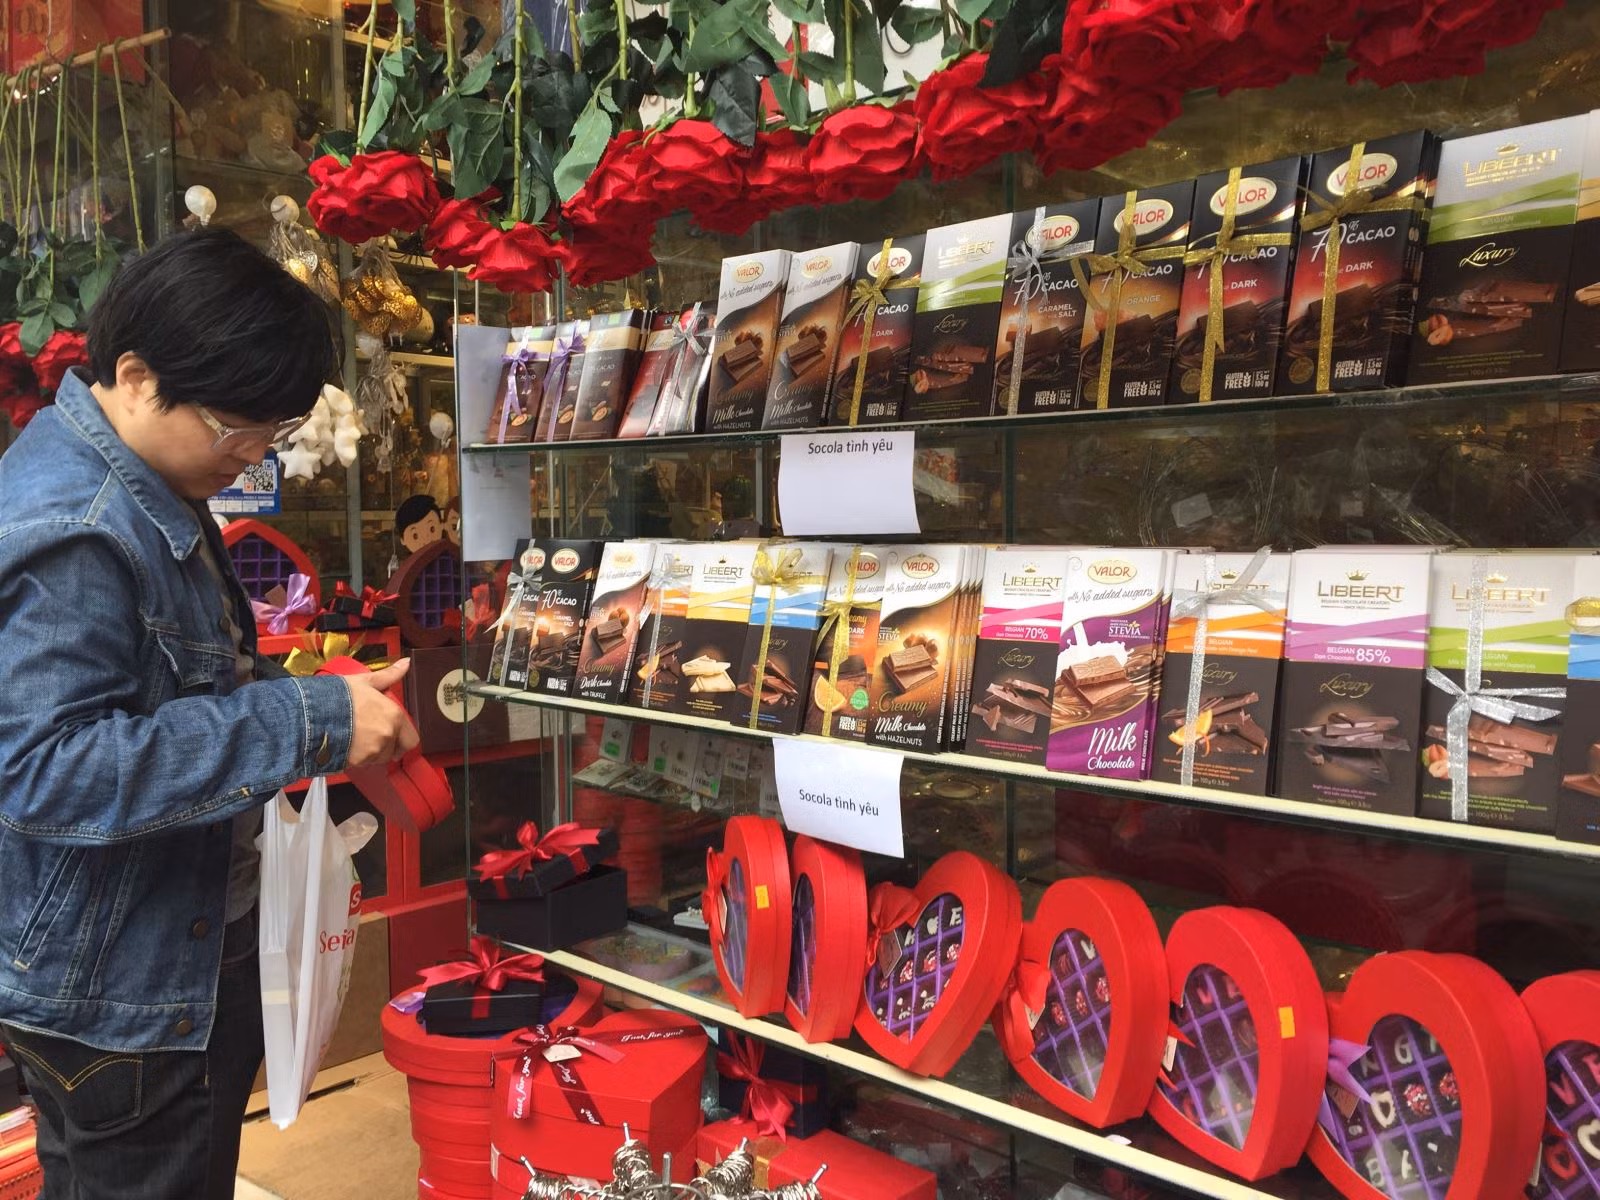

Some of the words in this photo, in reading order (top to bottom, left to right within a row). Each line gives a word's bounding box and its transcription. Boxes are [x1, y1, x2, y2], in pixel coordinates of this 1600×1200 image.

[1336, 163, 1388, 186] VLOR
[1218, 187, 1267, 208] VLOR
[1346, 225, 1395, 245] CACAO
[1457, 242, 1518, 269] Luxury
[871, 256, 906, 271] VLOR
[1346, 260, 1373, 273] DARK
[1041, 278, 1079, 292] CACAO
[1231, 279, 1258, 291] DARK
[1126, 294, 1161, 305] ORANGE
[877, 303, 909, 315] CACAO
[1038, 303, 1073, 314] CARAMEL
[1058, 308, 1077, 319] SALT
[1224, 378, 1243, 390] FREE
[1124, 387, 1140, 398] FREE
[1034, 396, 1050, 406] FREE
[808, 441, 843, 455] Socola
[846, 439, 869, 453] tình
[873, 438, 894, 456] yêu
[554, 556, 577, 567] VALOR
[907, 561, 936, 573] VALOR
[703, 563, 744, 579] LIBEERT
[1093, 565, 1131, 578] VALOR
[905, 580, 926, 593] added
[1002, 572, 1063, 591] LIBEERT
[1078, 589, 1092, 603] No
[1093, 588, 1121, 601] added
[1122, 588, 1155, 601] sugars
[1318, 581, 1406, 603] LIBEERT
[1451, 584, 1552, 606] LIEERT
[556, 597, 577, 606] CACAO
[1005, 626, 1025, 634] BELGIAN
[1024, 626, 1049, 641] 70%
[1109, 626, 1142, 637] STEVIA
[1327, 646, 1355, 655] BELGIAN
[1355, 647, 1392, 665] 85%
[1320, 672, 1375, 699] Luxury
[878, 690, 928, 719] Creamy
[874, 715, 904, 734] Milk
[875, 733, 887, 741] with
[887, 735, 923, 747] HAZELNUTS
[1087, 721, 1138, 755] Milk
[1087, 755, 1136, 771] Chocolate
[799, 788, 832, 807] Socola
[835, 795, 857, 812] tình
[859, 802, 880, 817] yêu
[646, 1030, 662, 1041] for
[517, 1076, 527, 1101] for
